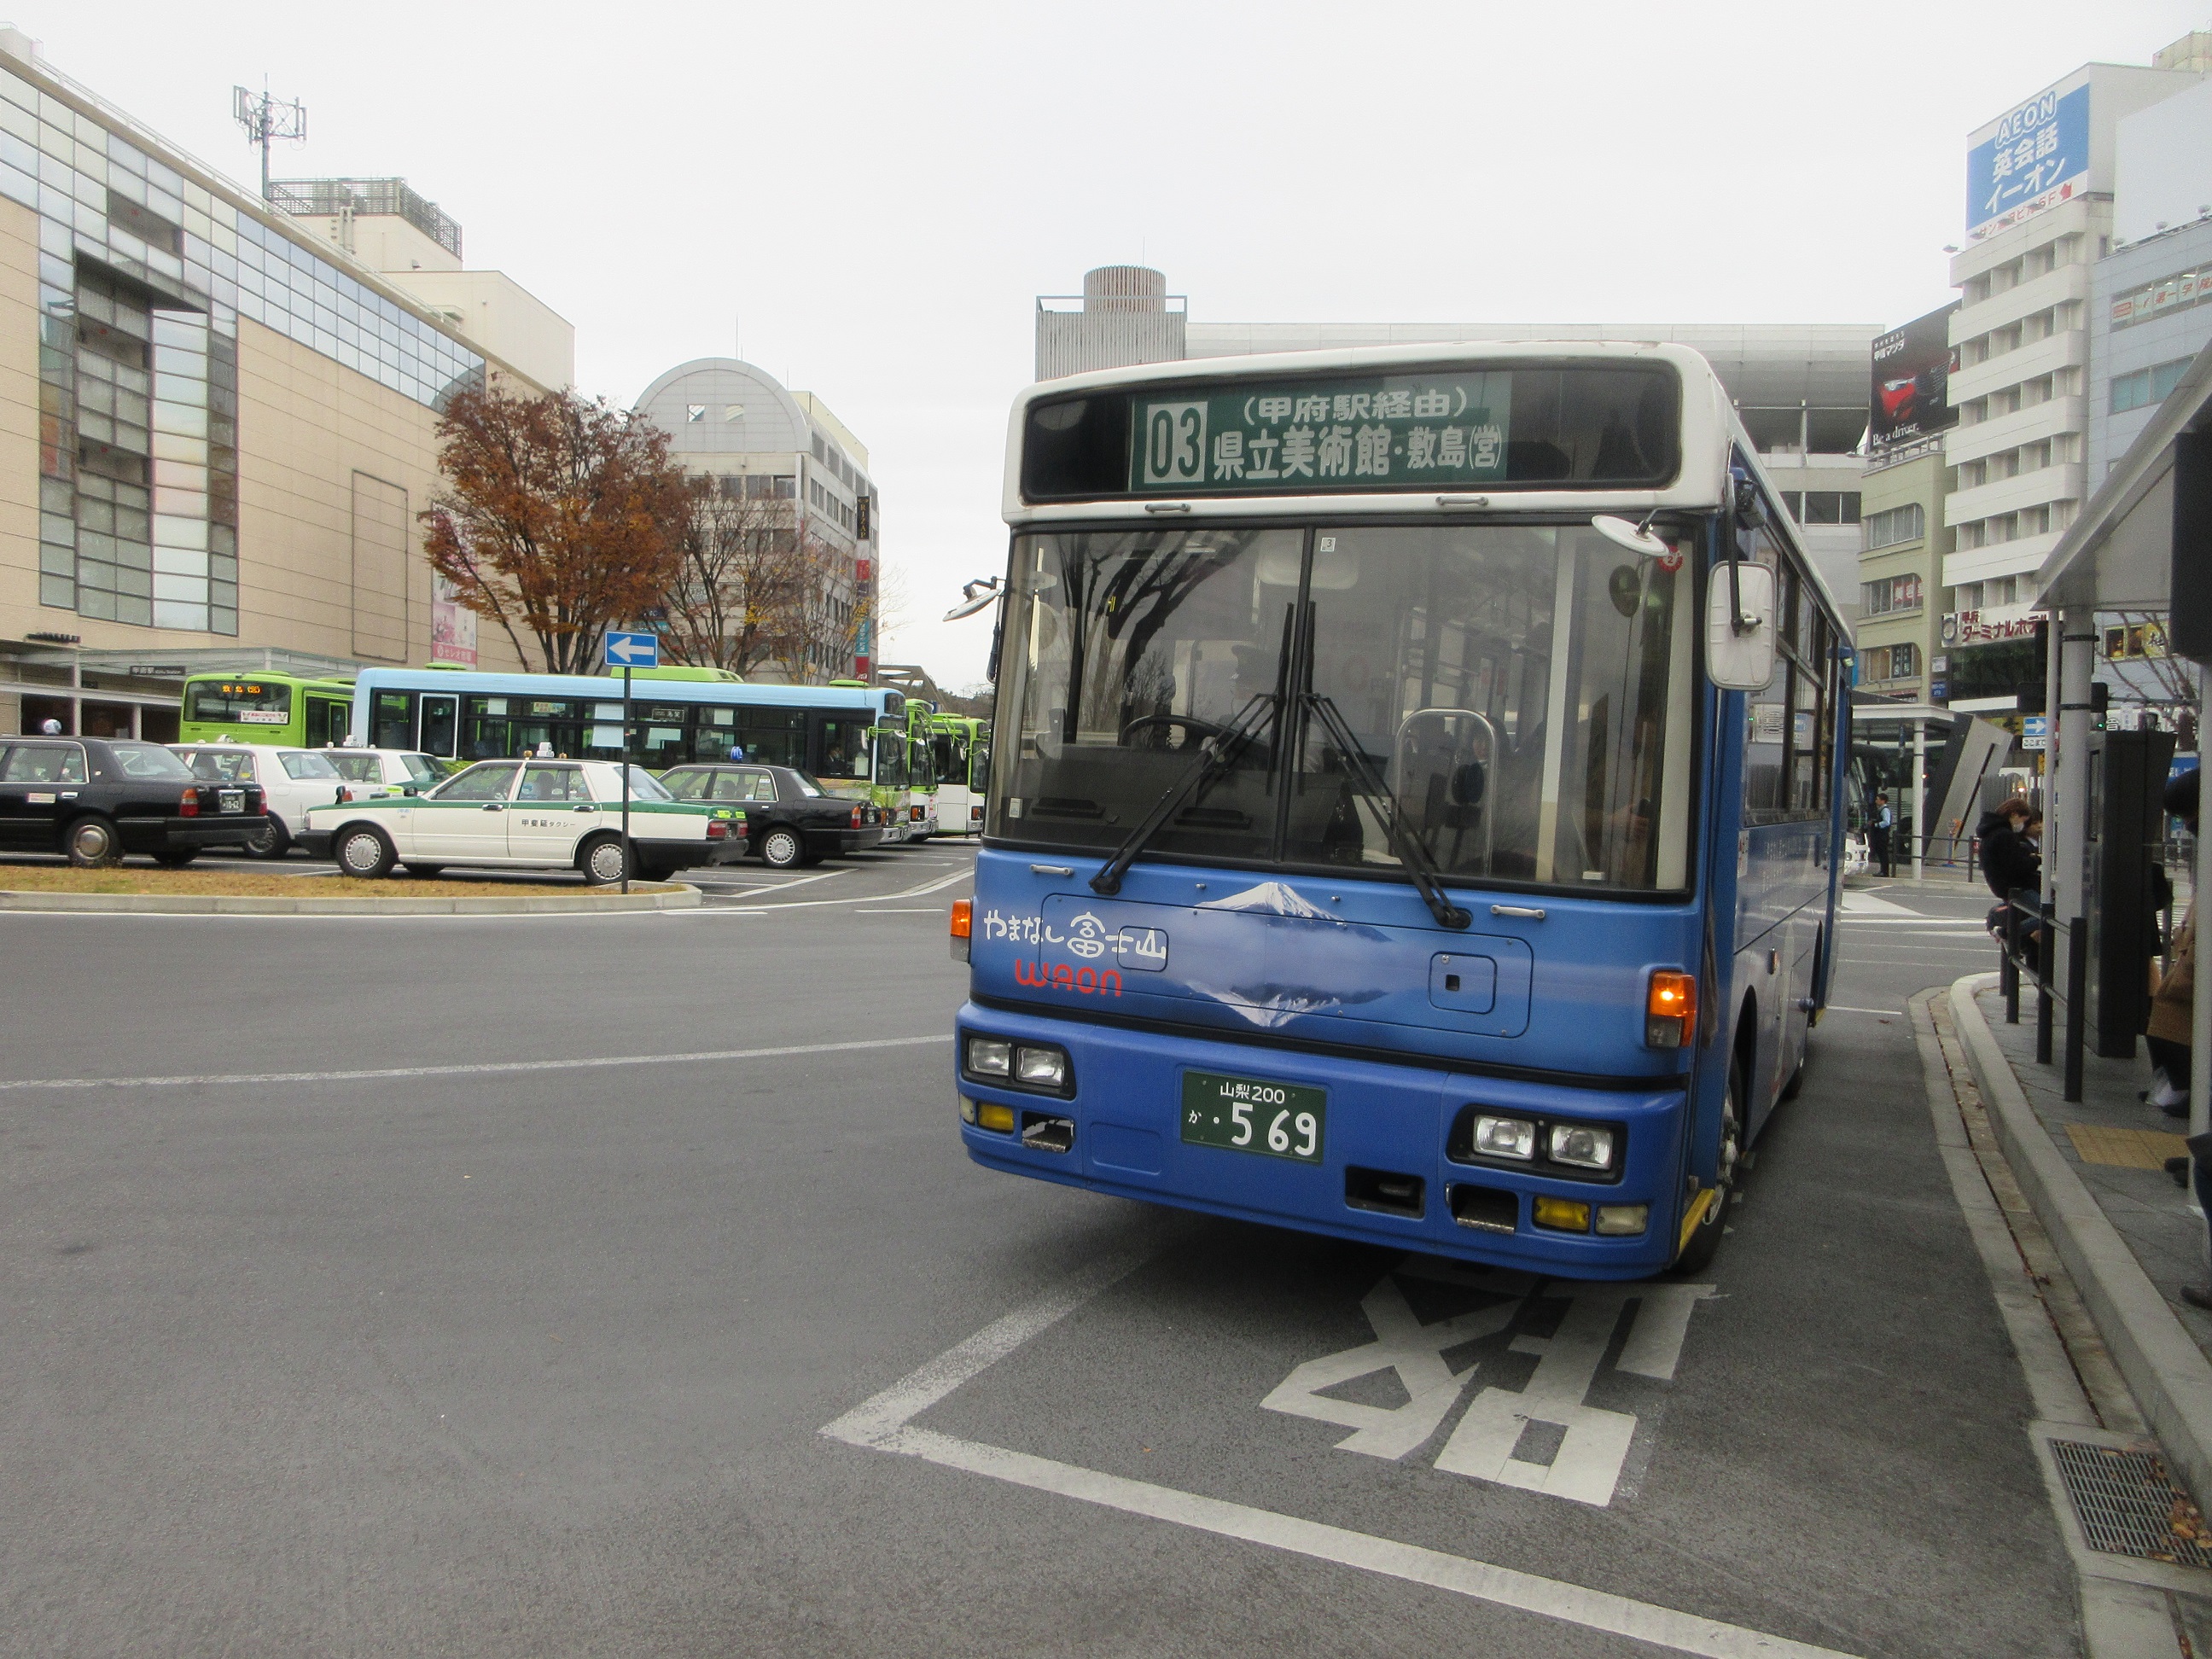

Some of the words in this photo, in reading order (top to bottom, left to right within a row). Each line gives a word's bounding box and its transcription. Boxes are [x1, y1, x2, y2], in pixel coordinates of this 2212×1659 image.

[1997, 93, 2055, 146] AEON
[1993, 120, 2058, 183] 英会話
[1984, 157, 2066, 213] イーオン
[1243, 386, 1467, 425] （甲府駅経由）
[1892, 422, 1919, 439] driver.
[1150, 407, 1202, 479] 03
[1213, 424, 1503, 480] 県立美術館・敷島（営）
[1327, 538, 1332, 548] 3
[983, 909, 1167, 959] やまなし富士山
